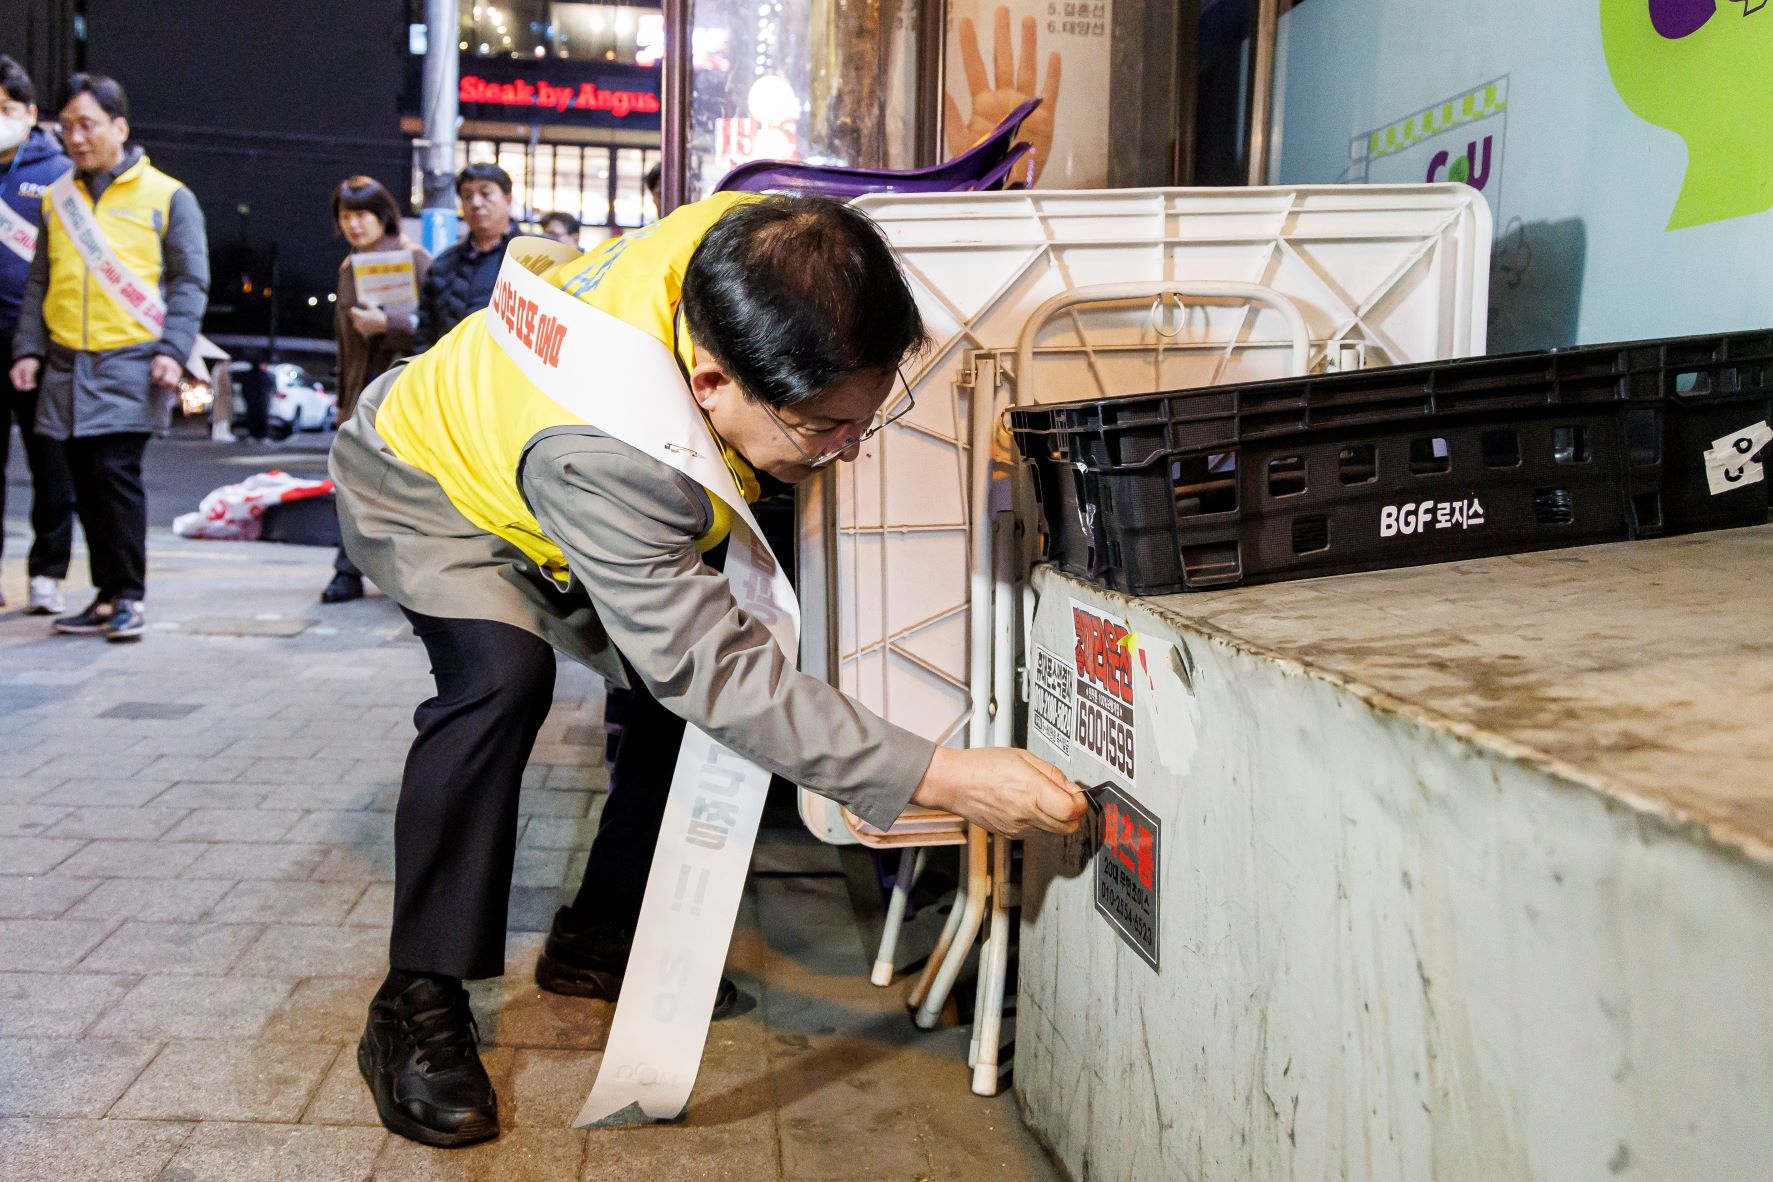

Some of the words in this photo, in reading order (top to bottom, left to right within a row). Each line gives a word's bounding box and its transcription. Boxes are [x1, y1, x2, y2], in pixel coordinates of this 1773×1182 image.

[459, 75, 535, 105] Steak
[536, 79, 574, 112] by
[574, 82, 660, 117] Angus
[1075, 698, 1135, 779] 1600-1599
